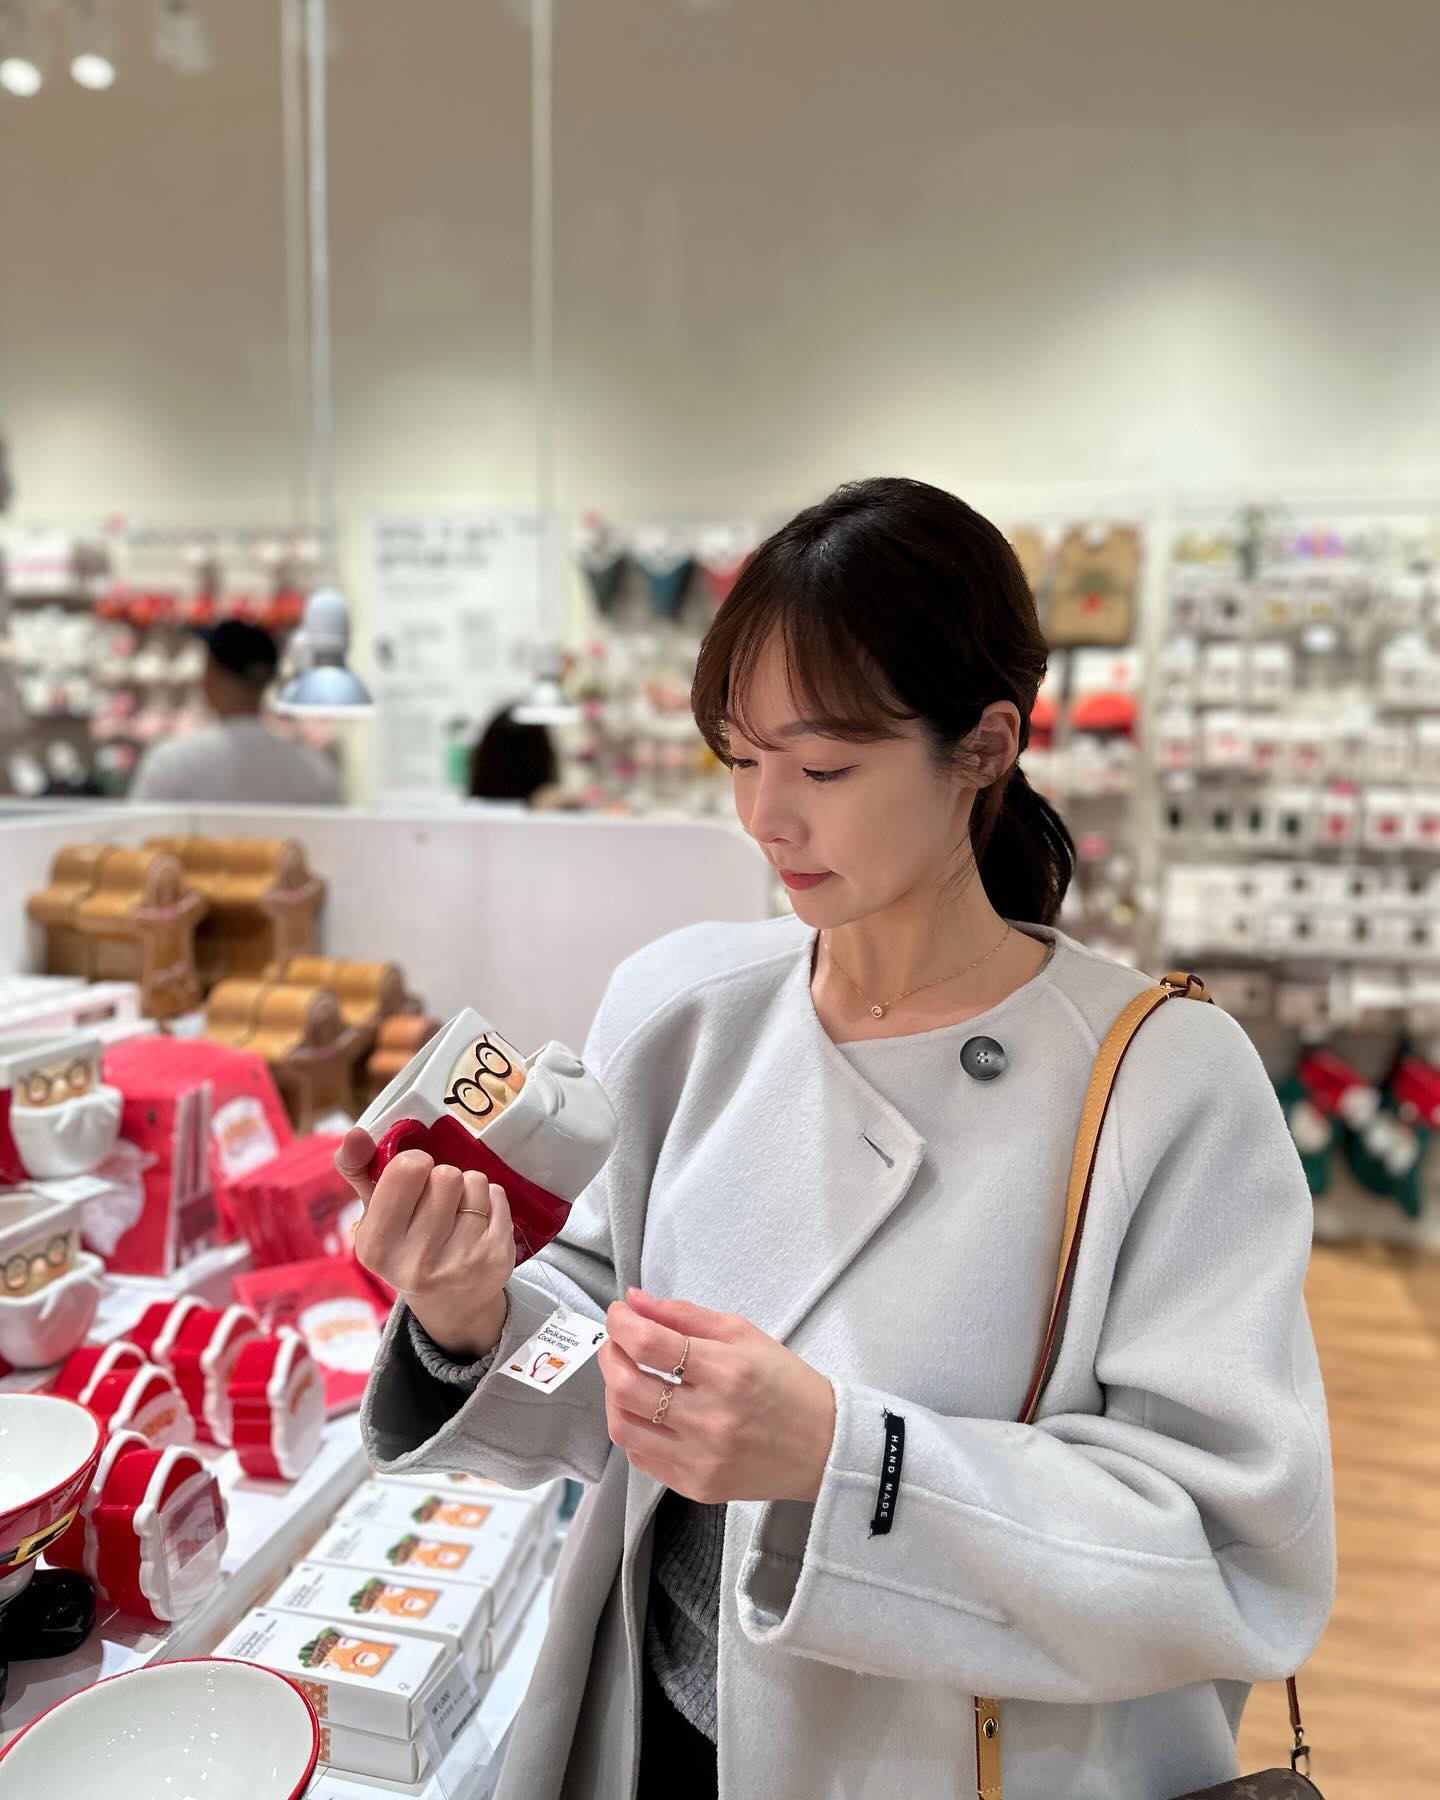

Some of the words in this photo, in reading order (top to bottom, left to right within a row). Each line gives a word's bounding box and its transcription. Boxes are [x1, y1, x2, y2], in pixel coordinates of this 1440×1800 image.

[538, 1333, 556, 1345] Cookie
[556, 1341, 570, 1352] mug
[887, 1435, 899, 1474] HAND
[880, 1482, 893, 1518] MADE
